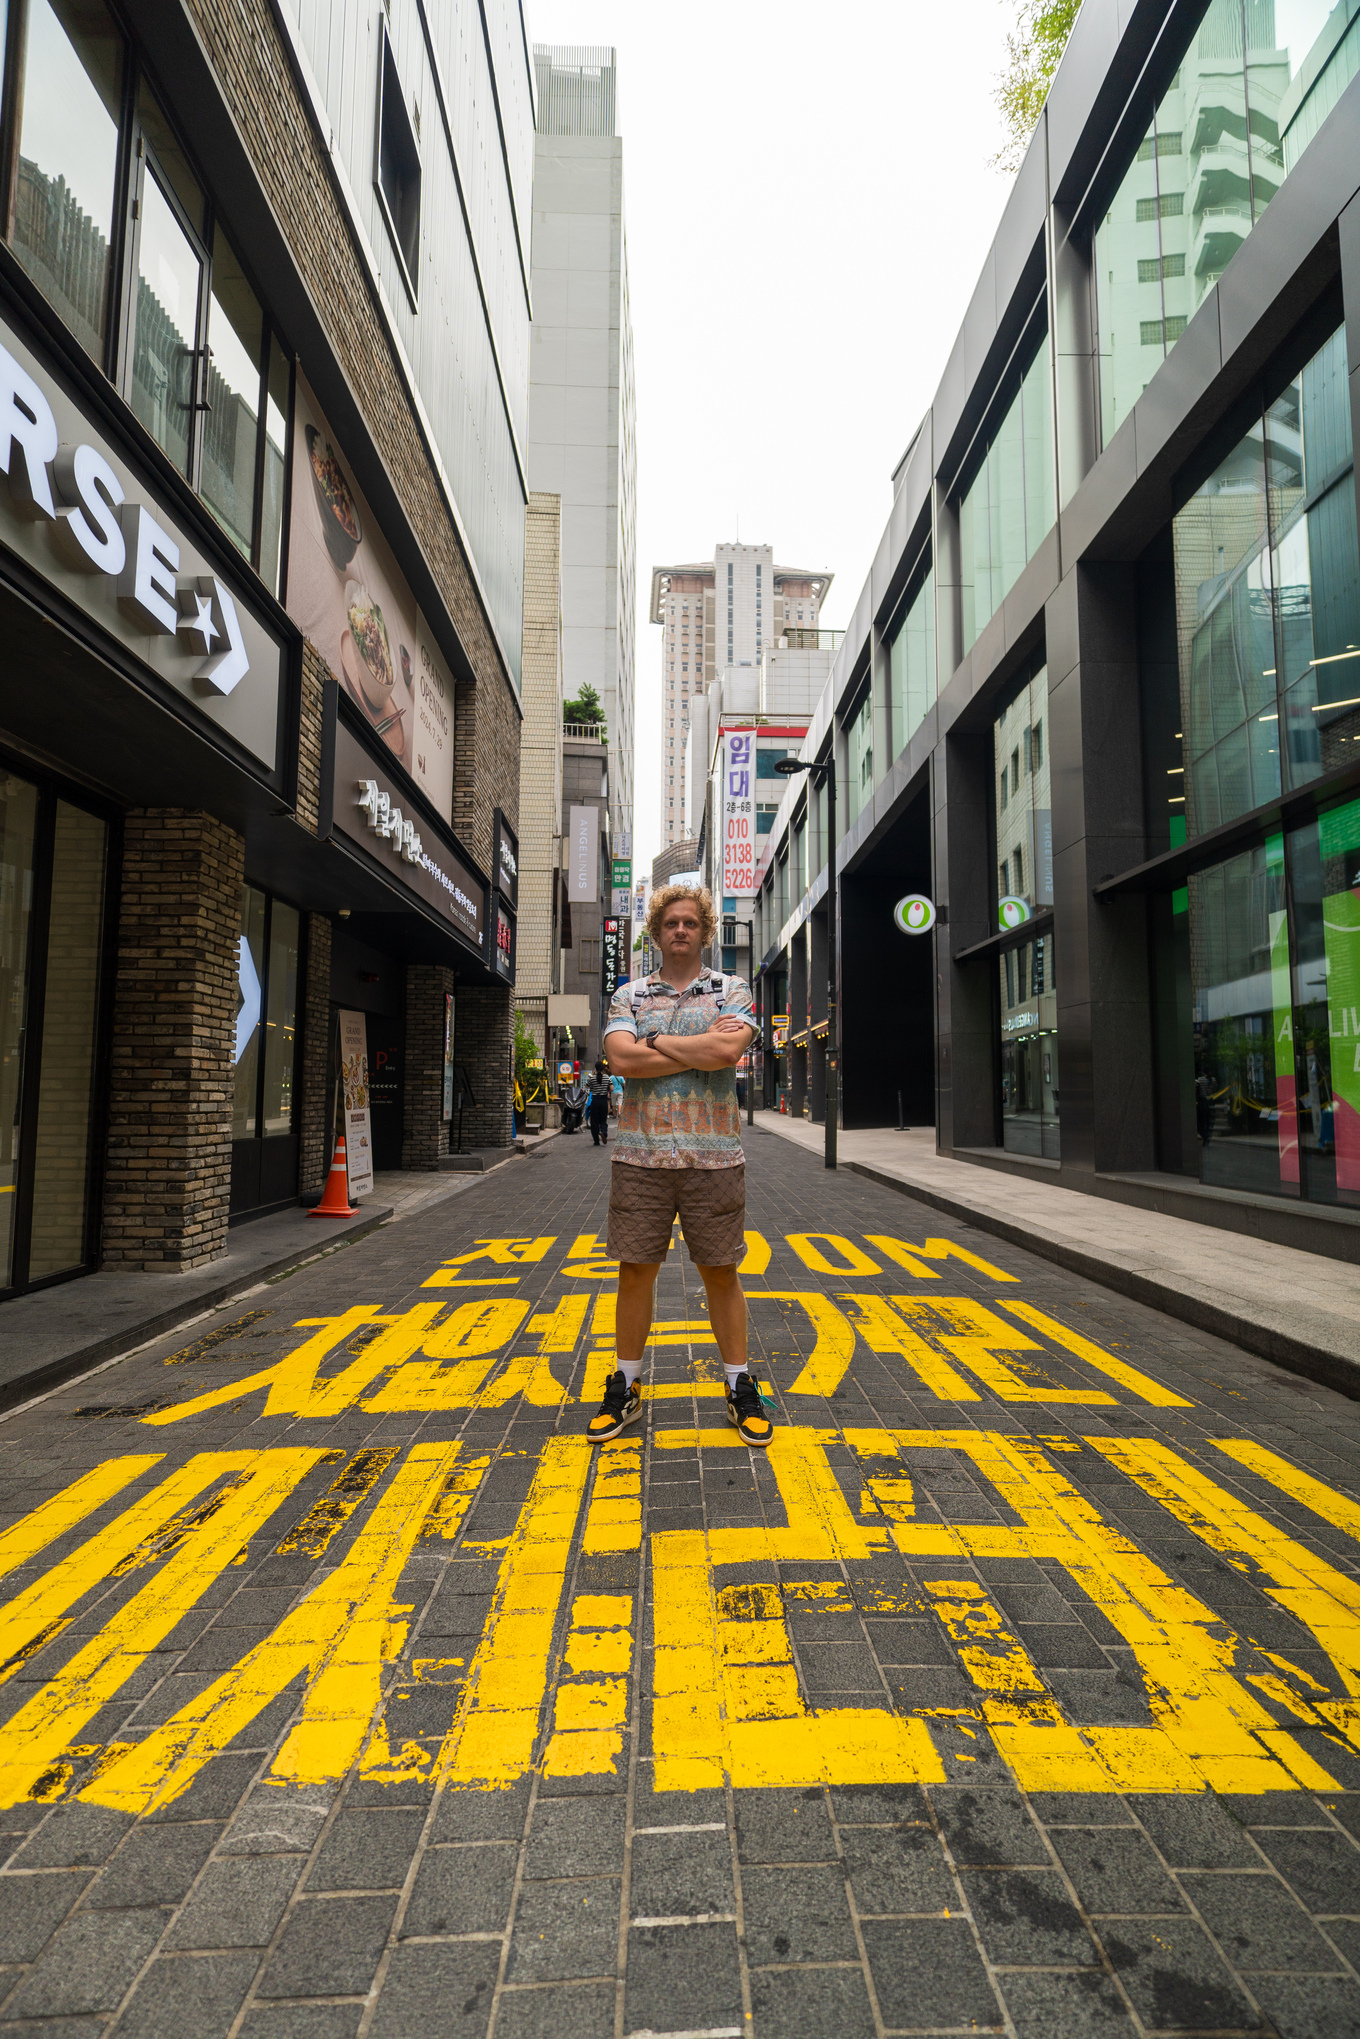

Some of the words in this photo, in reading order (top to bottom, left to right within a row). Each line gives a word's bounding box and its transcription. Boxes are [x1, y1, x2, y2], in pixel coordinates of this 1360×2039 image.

[420, 644, 445, 699] GRAND
[419, 675, 449, 736] OPENING
[729, 735, 750, 798] 임대
[726, 801, 752, 813] 2층-6층
[727, 818, 749, 839] 010
[578, 818, 588, 889] ANGELINUS
[724, 843, 752, 865] 3138
[614, 874, 630, 883] 안경
[725, 868, 753, 889] 5226
[620, 895, 629, 913] 내과
[376, 1051, 388, 1070] P
